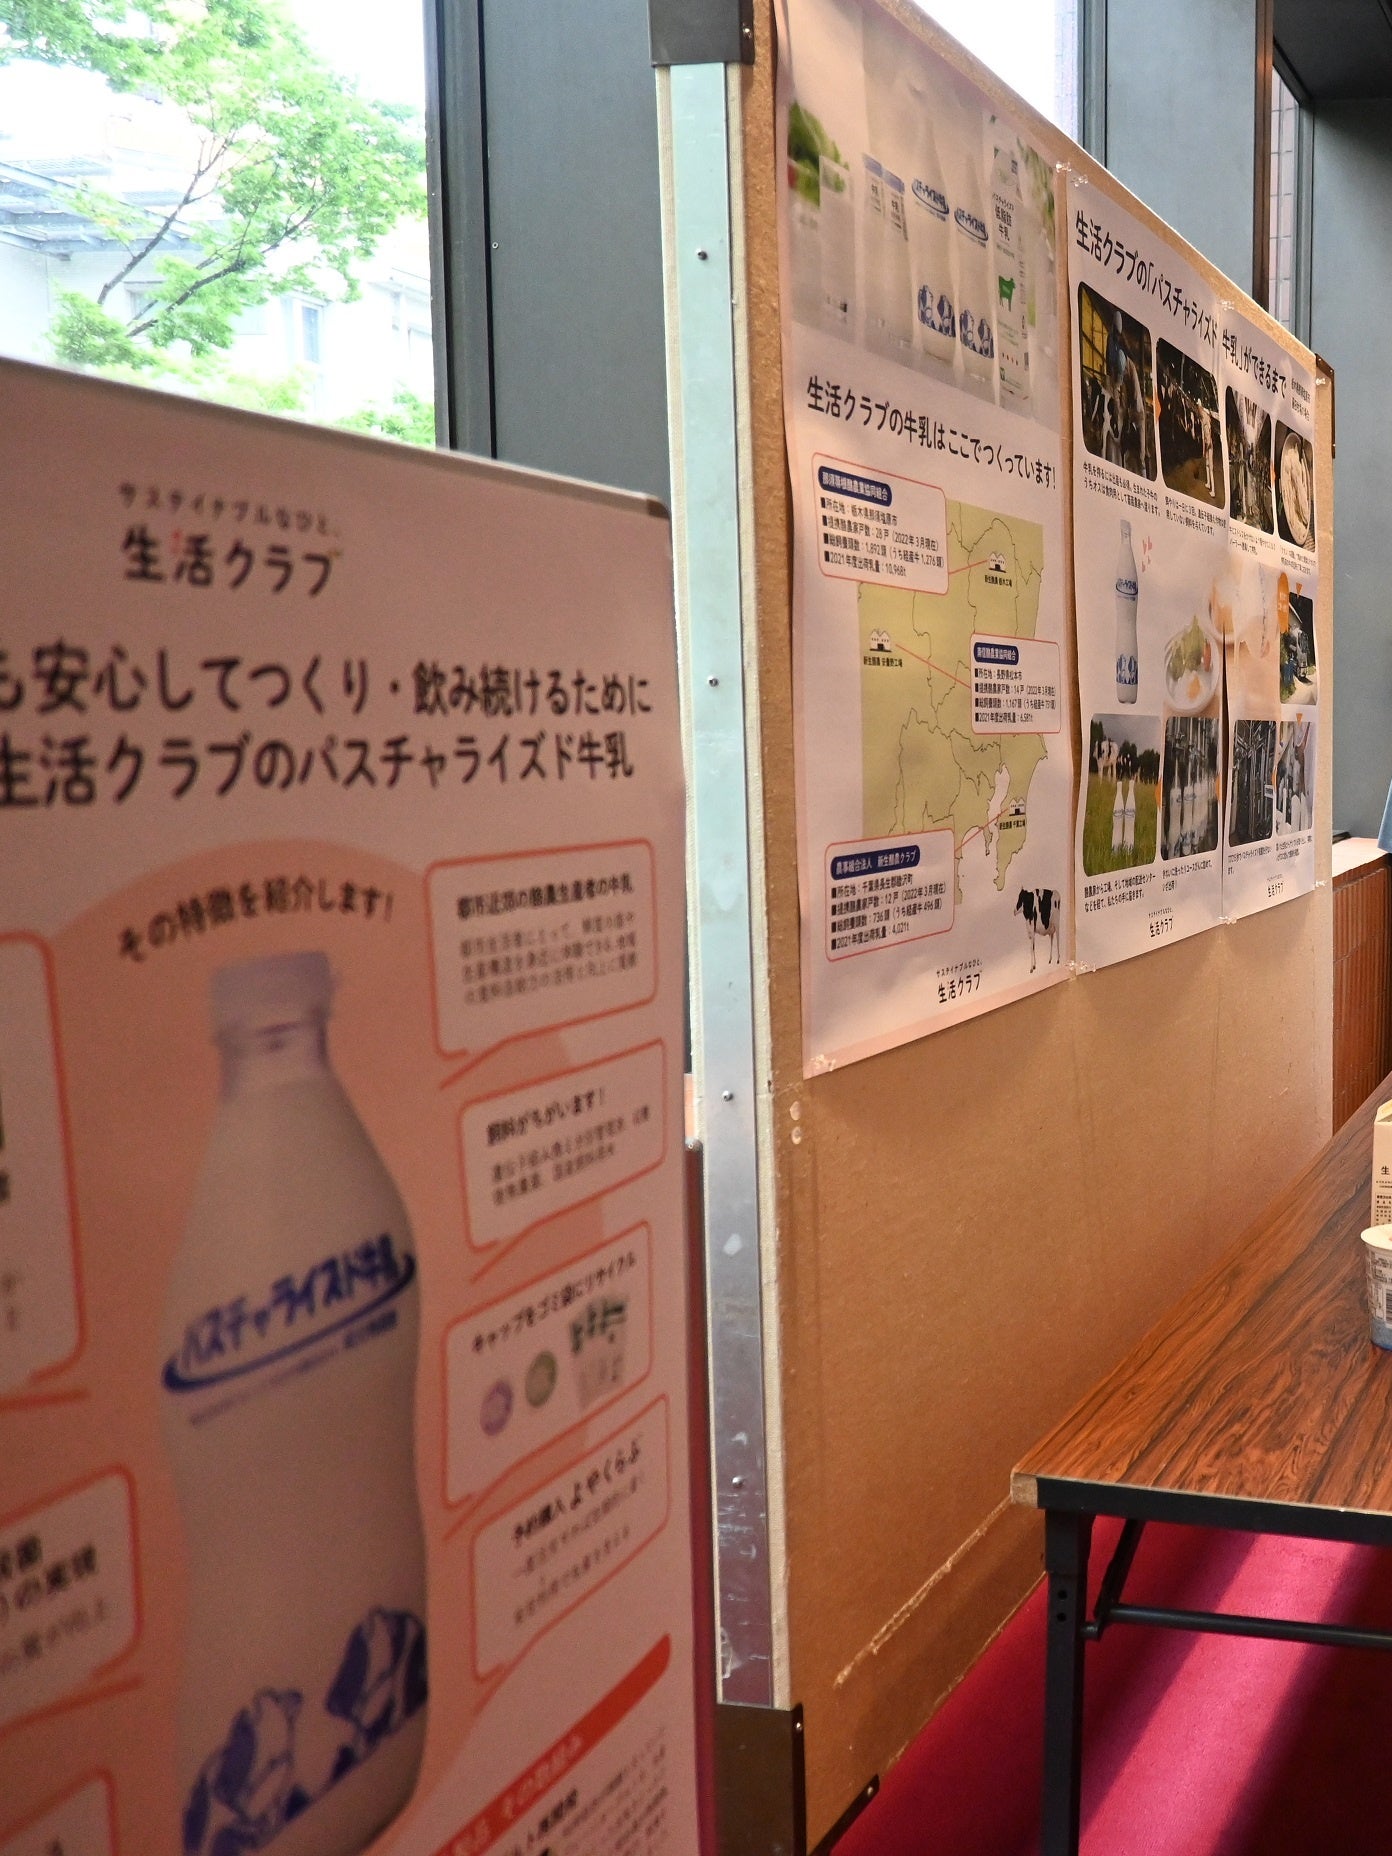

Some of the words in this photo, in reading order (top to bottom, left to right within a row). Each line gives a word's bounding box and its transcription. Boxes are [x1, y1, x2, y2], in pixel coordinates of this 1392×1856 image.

[806, 375, 1057, 490] 生活クラブの牛乳はここでつくっています！
[122, 523, 342, 597] 生活クラブ
[0, 731, 635, 808] 生活クラブのパスチャライズド牛乳
[1149, 916, 1174, 938] 生活クラブ
[938, 970, 983, 1003] 生活クラブ
